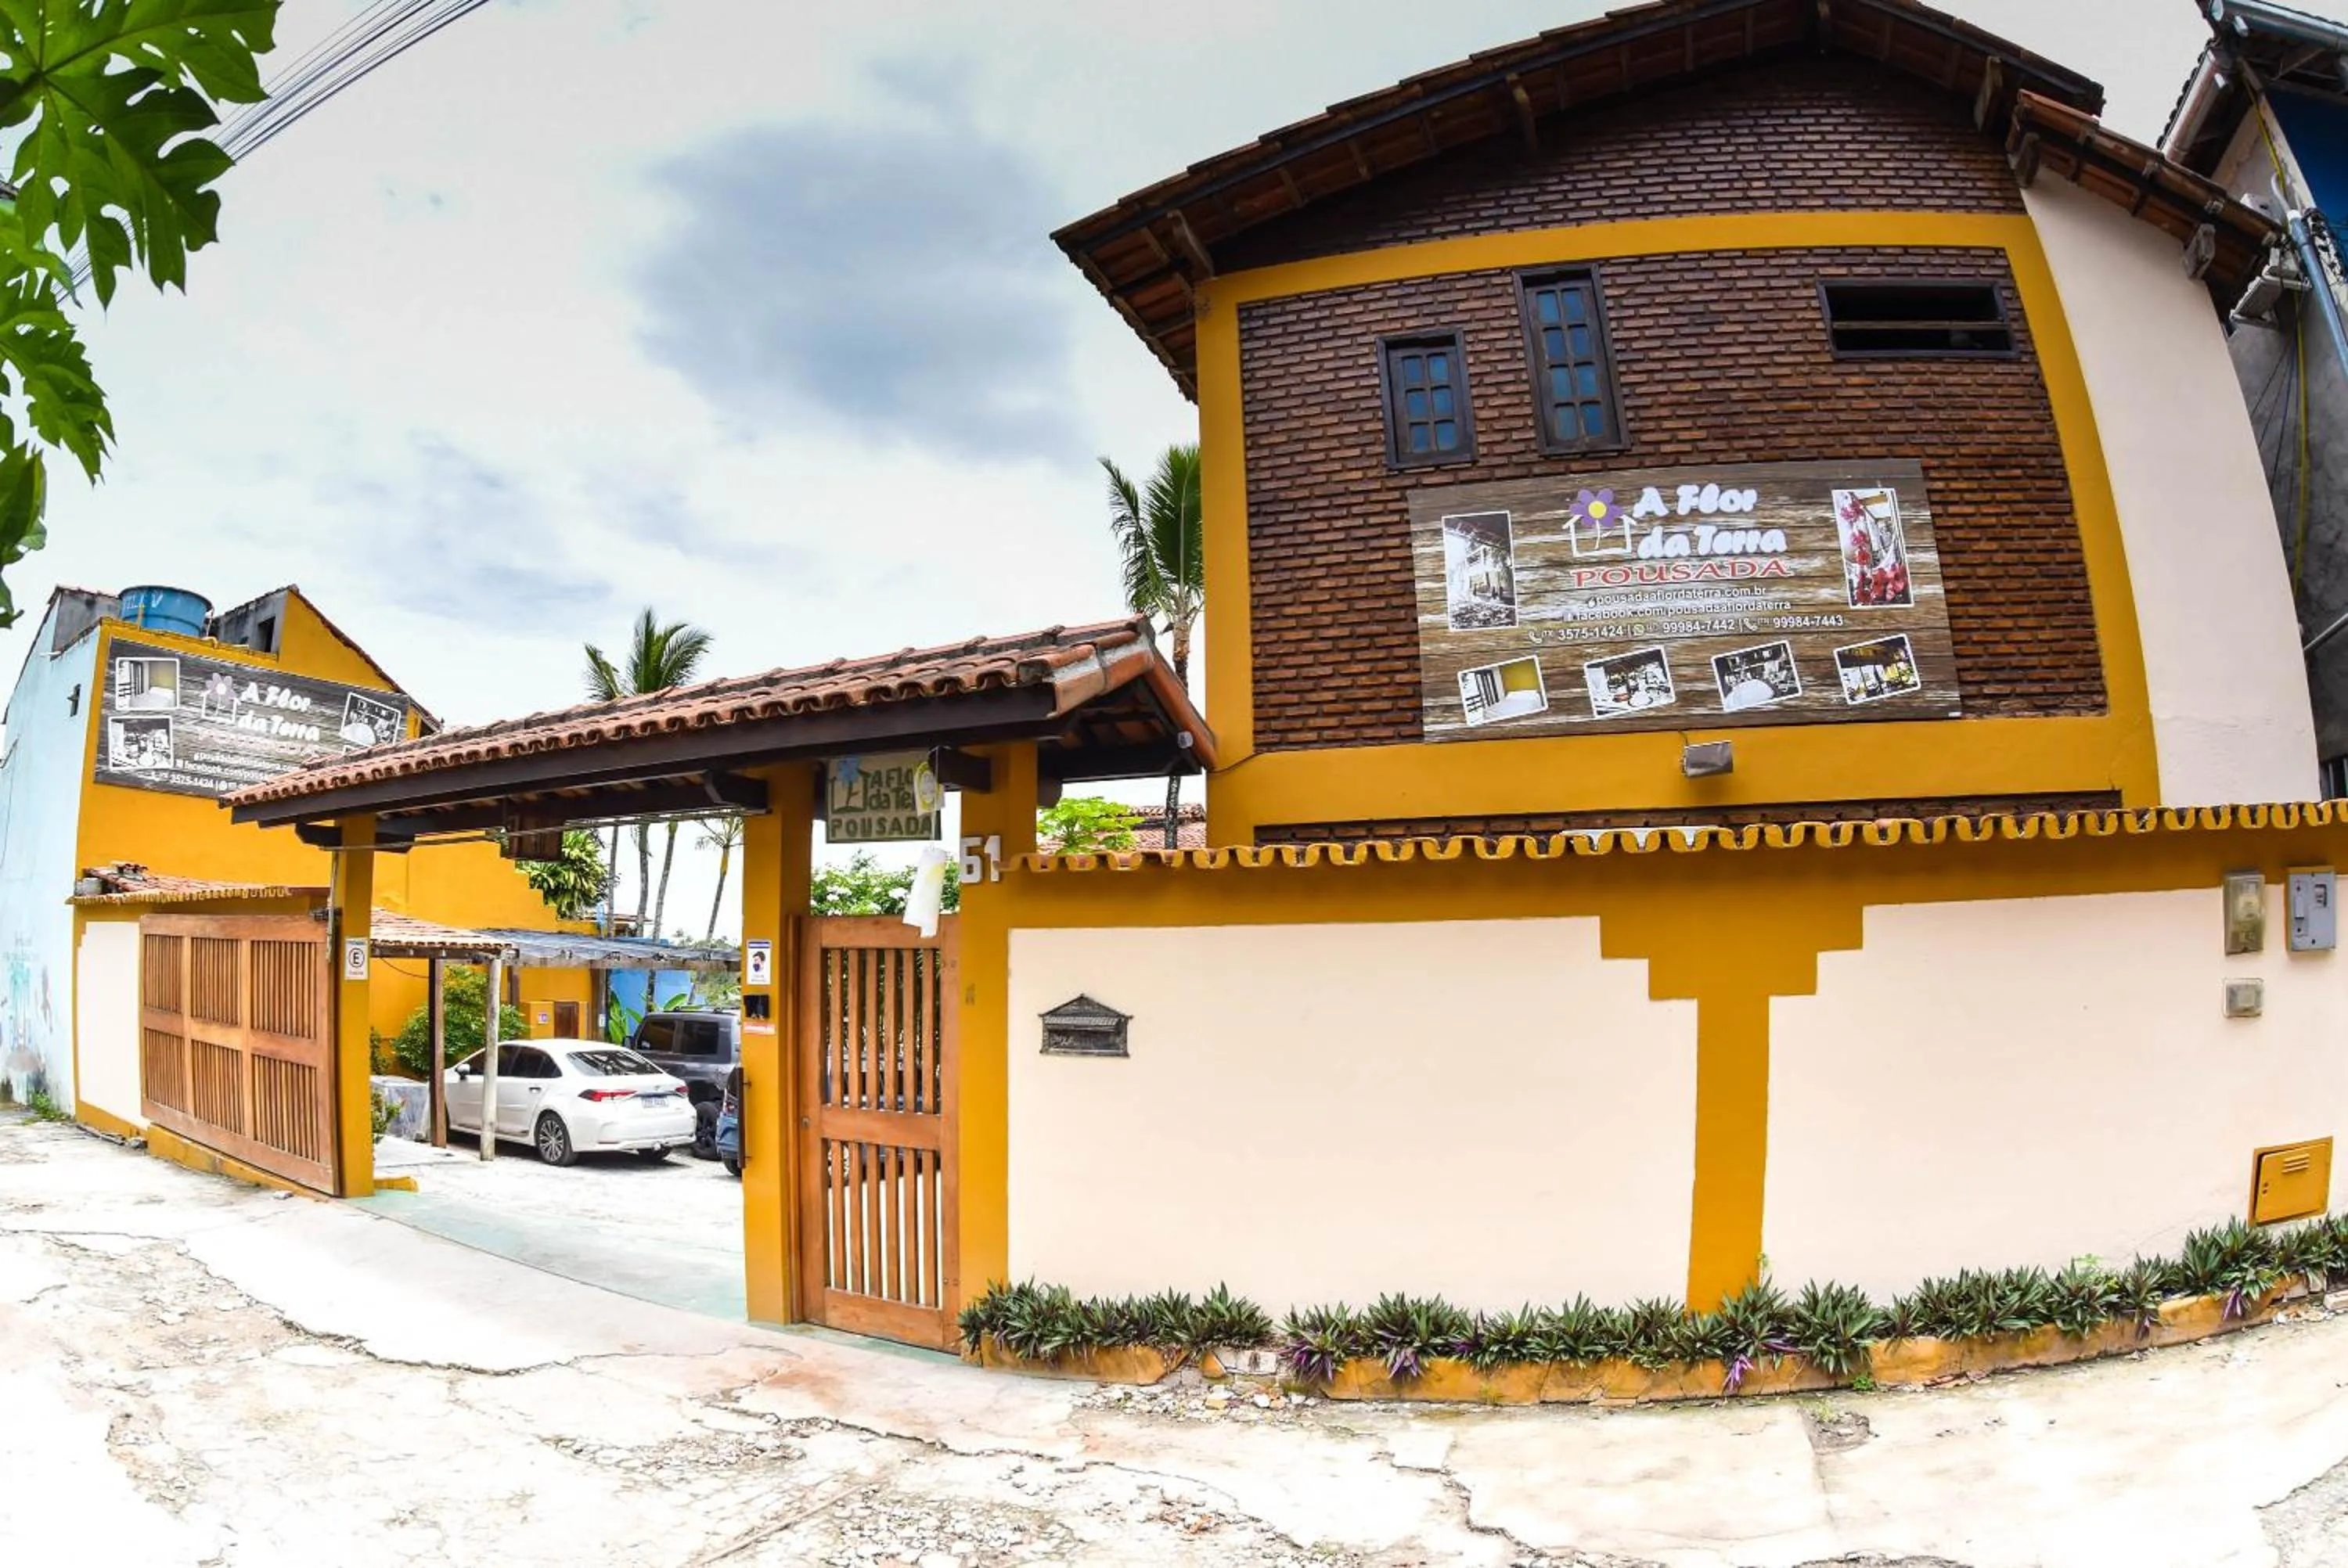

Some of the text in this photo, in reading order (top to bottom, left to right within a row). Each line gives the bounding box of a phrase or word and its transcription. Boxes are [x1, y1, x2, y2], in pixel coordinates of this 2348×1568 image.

[1632, 483, 1758, 519] A Flor
[1637, 524, 1788, 559] da Terra
[1570, 557, 1795, 589] POUSADA
[1558, 625, 1623, 641] 3575-1424
[1662, 619, 1735, 634] 99984-7442
[1773, 614, 1843, 628] 99984-7443
[239, 682, 311, 712] A Flor
[237, 710, 320, 742] da Terra
[868, 788, 891, 810] da
[830, 816, 932, 838] POUSADA
[960, 835, 1001, 883] 61
[353, 951, 361, 965] E
